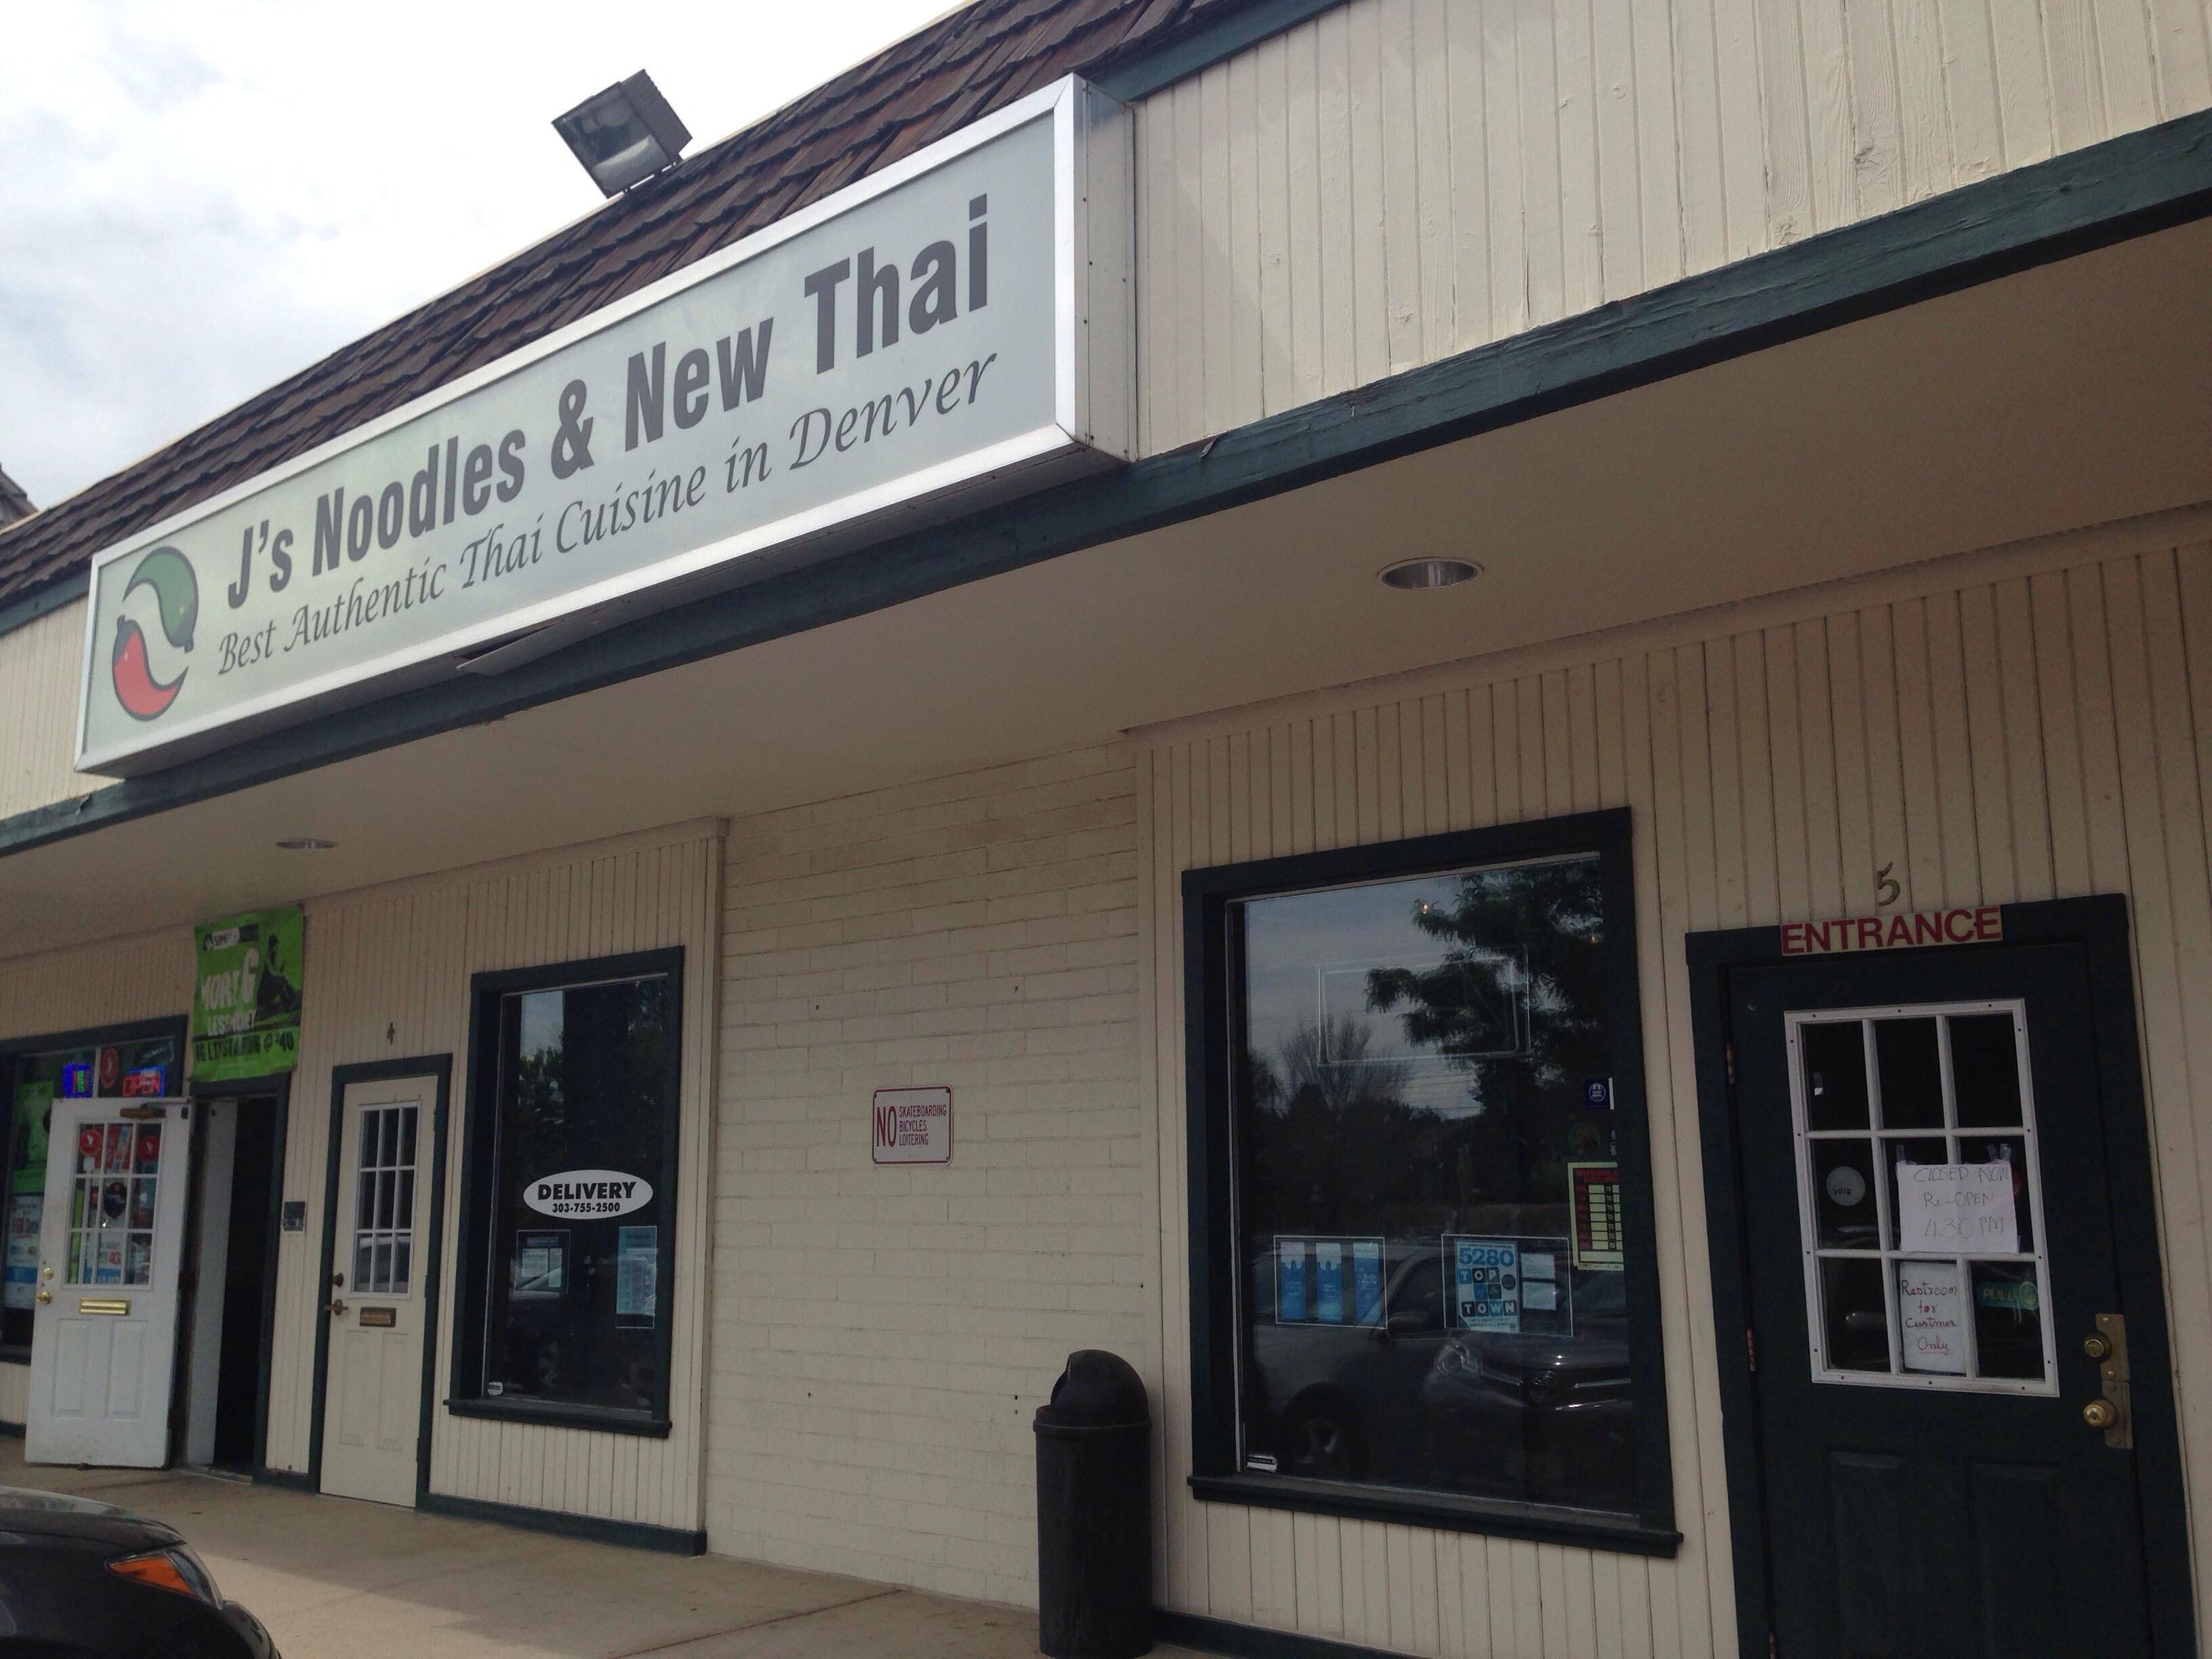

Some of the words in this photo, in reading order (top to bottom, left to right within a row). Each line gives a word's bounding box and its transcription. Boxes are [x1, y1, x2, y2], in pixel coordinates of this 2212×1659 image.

[228, 519, 293, 609] J's
[312, 429, 526, 577] Noodles
[551, 379, 594, 480] &
[625, 316, 774, 452] New
[804, 192, 987, 375] Thai
[218, 619, 276, 675] Best
[283, 556, 447, 652] Authentic
[459, 512, 544, 590] Thai
[556, 465, 707, 554] Cuisine
[724, 435, 772, 493] in
[789, 352, 998, 471] Denver
[1877, 861, 1901, 907] 5
[1780, 907, 2002, 955] ENTRANCE
[241, 947, 260, 1003] G
[899, 1104, 947, 1118] SKATEBOARDING
[876, 1105, 897, 1147] NO
[899, 1120, 927, 1132] BICYCLES
[899, 1133, 928, 1146] LOITERING
[537, 1181, 637, 1201] DELIVERY
[1832, 1187, 1853, 1196] yelp
[552, 1202, 621, 1213] 303-755-2500
[1980, 1215, 2004, 1237] PM
[1458, 1247, 1515, 1267] 5280
[1460, 1268, 1498, 1282] TOP
[1901, 1279, 1957, 1296] Restroom
[1982, 1288, 2014, 1301] PULL
[1462, 1300, 1516, 1315] TOWN
[1918, 1299, 1938, 1313] for
[1917, 1334, 1949, 1355] Only
